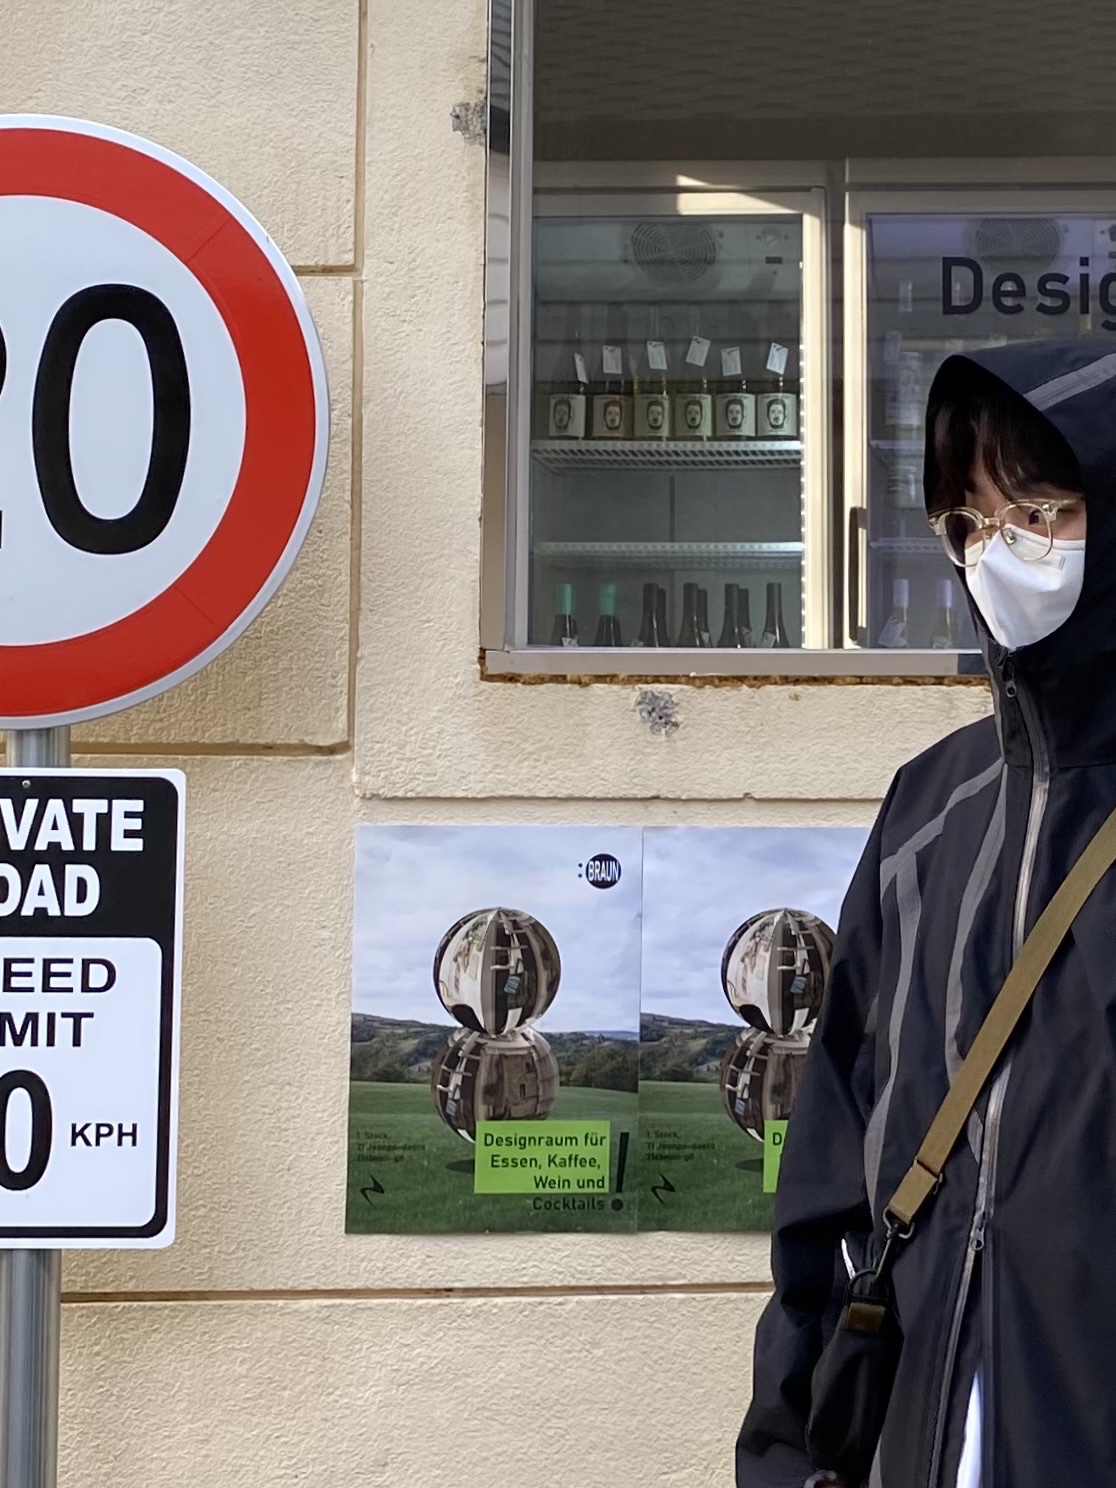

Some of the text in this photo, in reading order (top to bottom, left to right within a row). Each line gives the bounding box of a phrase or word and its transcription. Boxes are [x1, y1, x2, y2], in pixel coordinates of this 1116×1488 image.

[588, 860, 619, 882] BRAUN
[2, 957, 117, 993] EED
[70, 1122, 138, 1148] KPH
[484, 1132, 607, 1149] Designraum für
[490, 1153, 601, 1170] Essen, Kaffee,
[533, 1175, 606, 1189] Wein und
[532, 1196, 606, 1212] Cocktails
